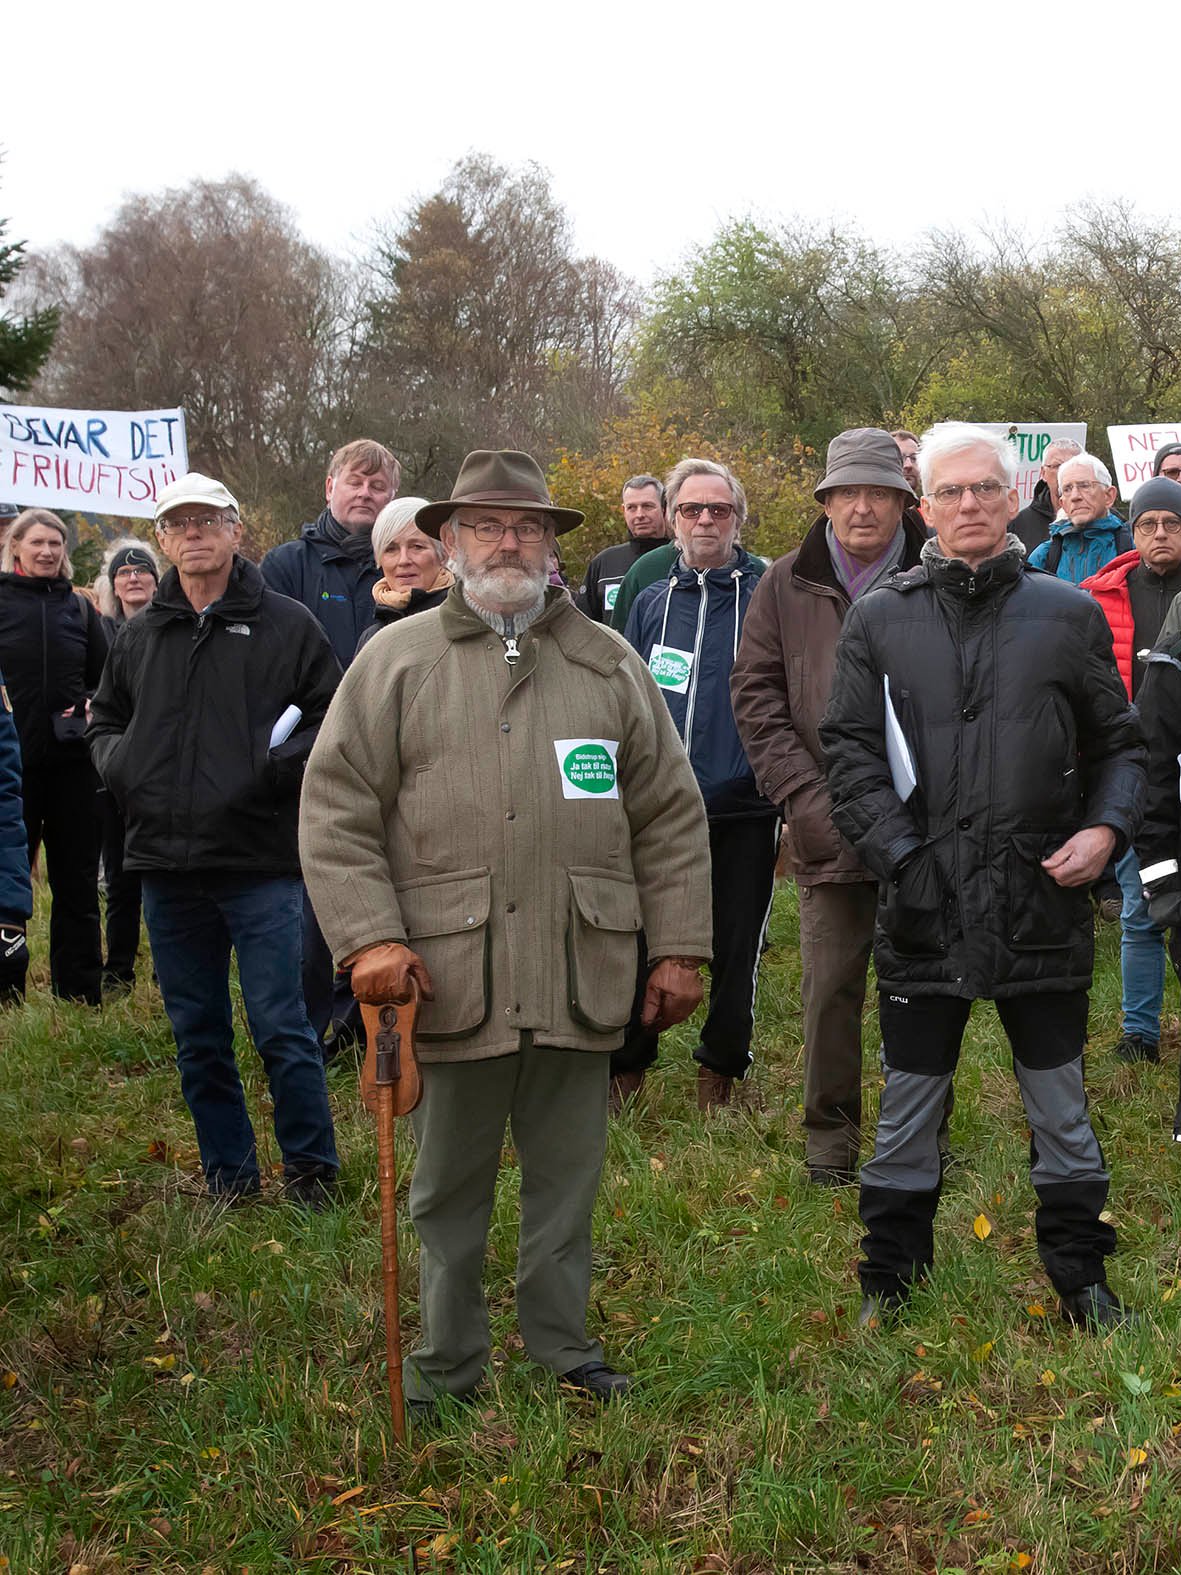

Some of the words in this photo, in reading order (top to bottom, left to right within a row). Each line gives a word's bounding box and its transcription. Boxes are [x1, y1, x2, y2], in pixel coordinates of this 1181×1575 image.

[3, 413, 110, 458] BEVAR
[130, 418, 179, 460] DET
[1128, 431, 1179, 451] NEJ
[1008, 433, 1052, 462] TUR
[570, 762, 580, 770] Ja
[581, 762, 592, 770] tak
[570, 772, 584, 781] Nej
